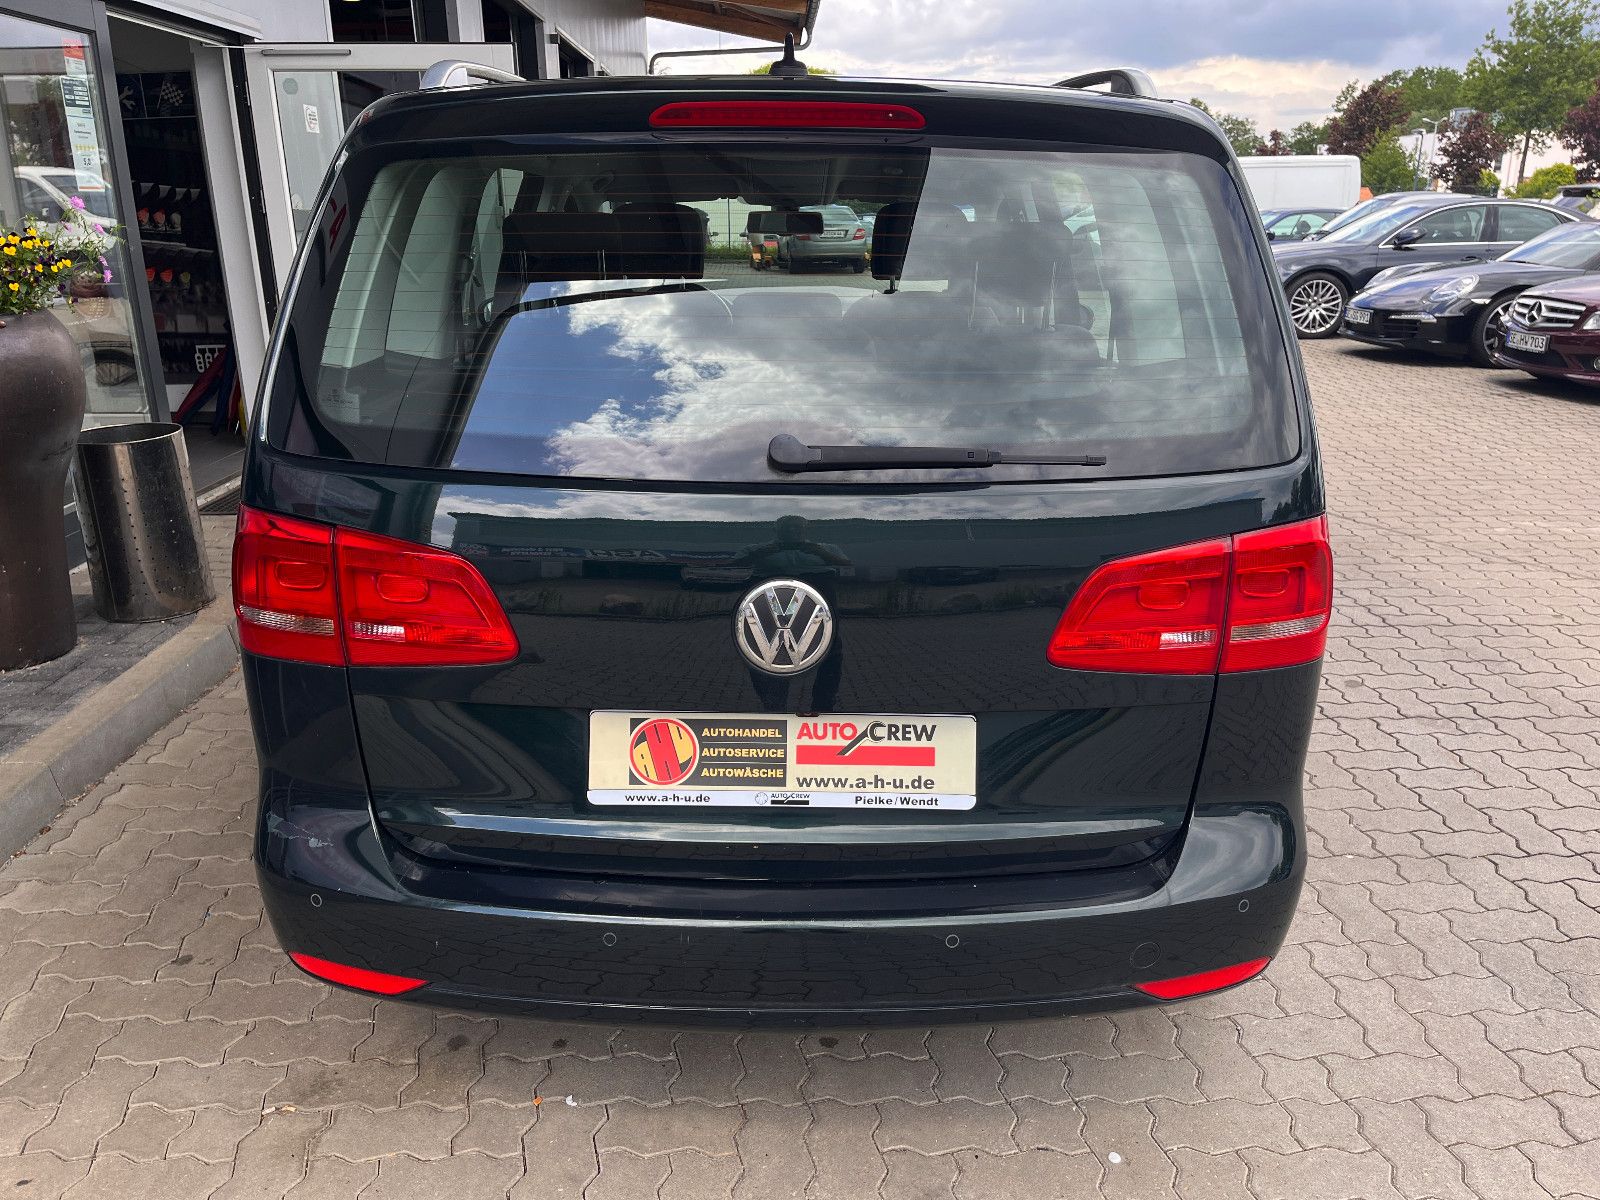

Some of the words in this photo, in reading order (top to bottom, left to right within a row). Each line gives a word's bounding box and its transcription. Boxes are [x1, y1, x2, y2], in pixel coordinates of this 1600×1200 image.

[701, 727, 783, 738] AUTOHANDEL
[796, 722, 858, 740] AUTO
[867, 720, 937, 741] CREW
[701, 747, 785, 758] AUTOSERVICE
[700, 766, 784, 778] AUTOWÄSCHE
[796, 774, 935, 790] www.a-h-u.de
[624, 793, 711, 803] www.a-h-u.de
[855, 795, 939, 806] Pielke/Wendt
